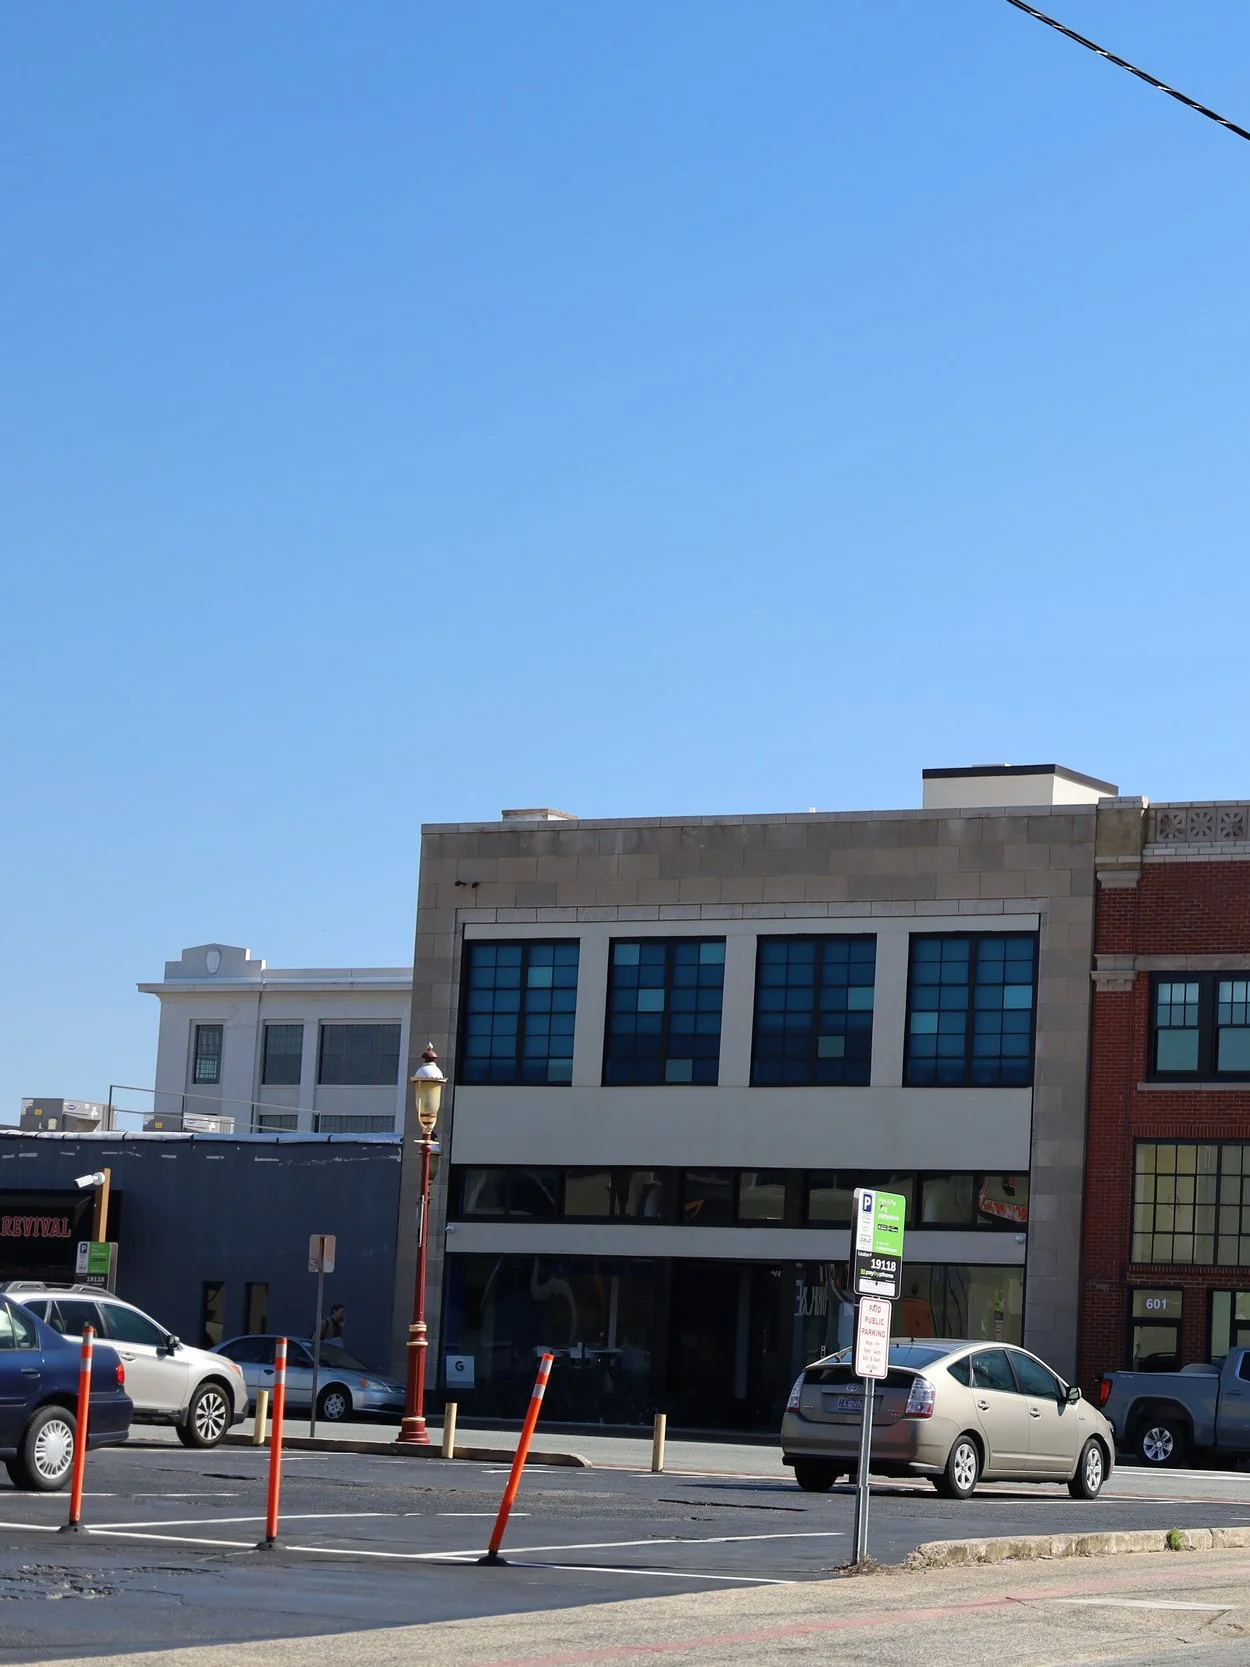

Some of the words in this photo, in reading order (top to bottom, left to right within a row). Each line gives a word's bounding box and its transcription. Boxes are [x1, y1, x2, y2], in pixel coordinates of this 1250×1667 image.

[864, 1195, 872, 1211] P
[0, 1215, 72, 1237] REVIVAL
[870, 1258, 897, 1272] 19118
[865, 1269, 894, 1279] paybyphone
[868, 1304, 881, 1313] PAID
[1146, 1298, 1167, 1310] 601
[864, 1316, 885, 1326] PUBLIC
[861, 1327, 886, 1338] PARKING
[454, 1360, 464, 1372] G
